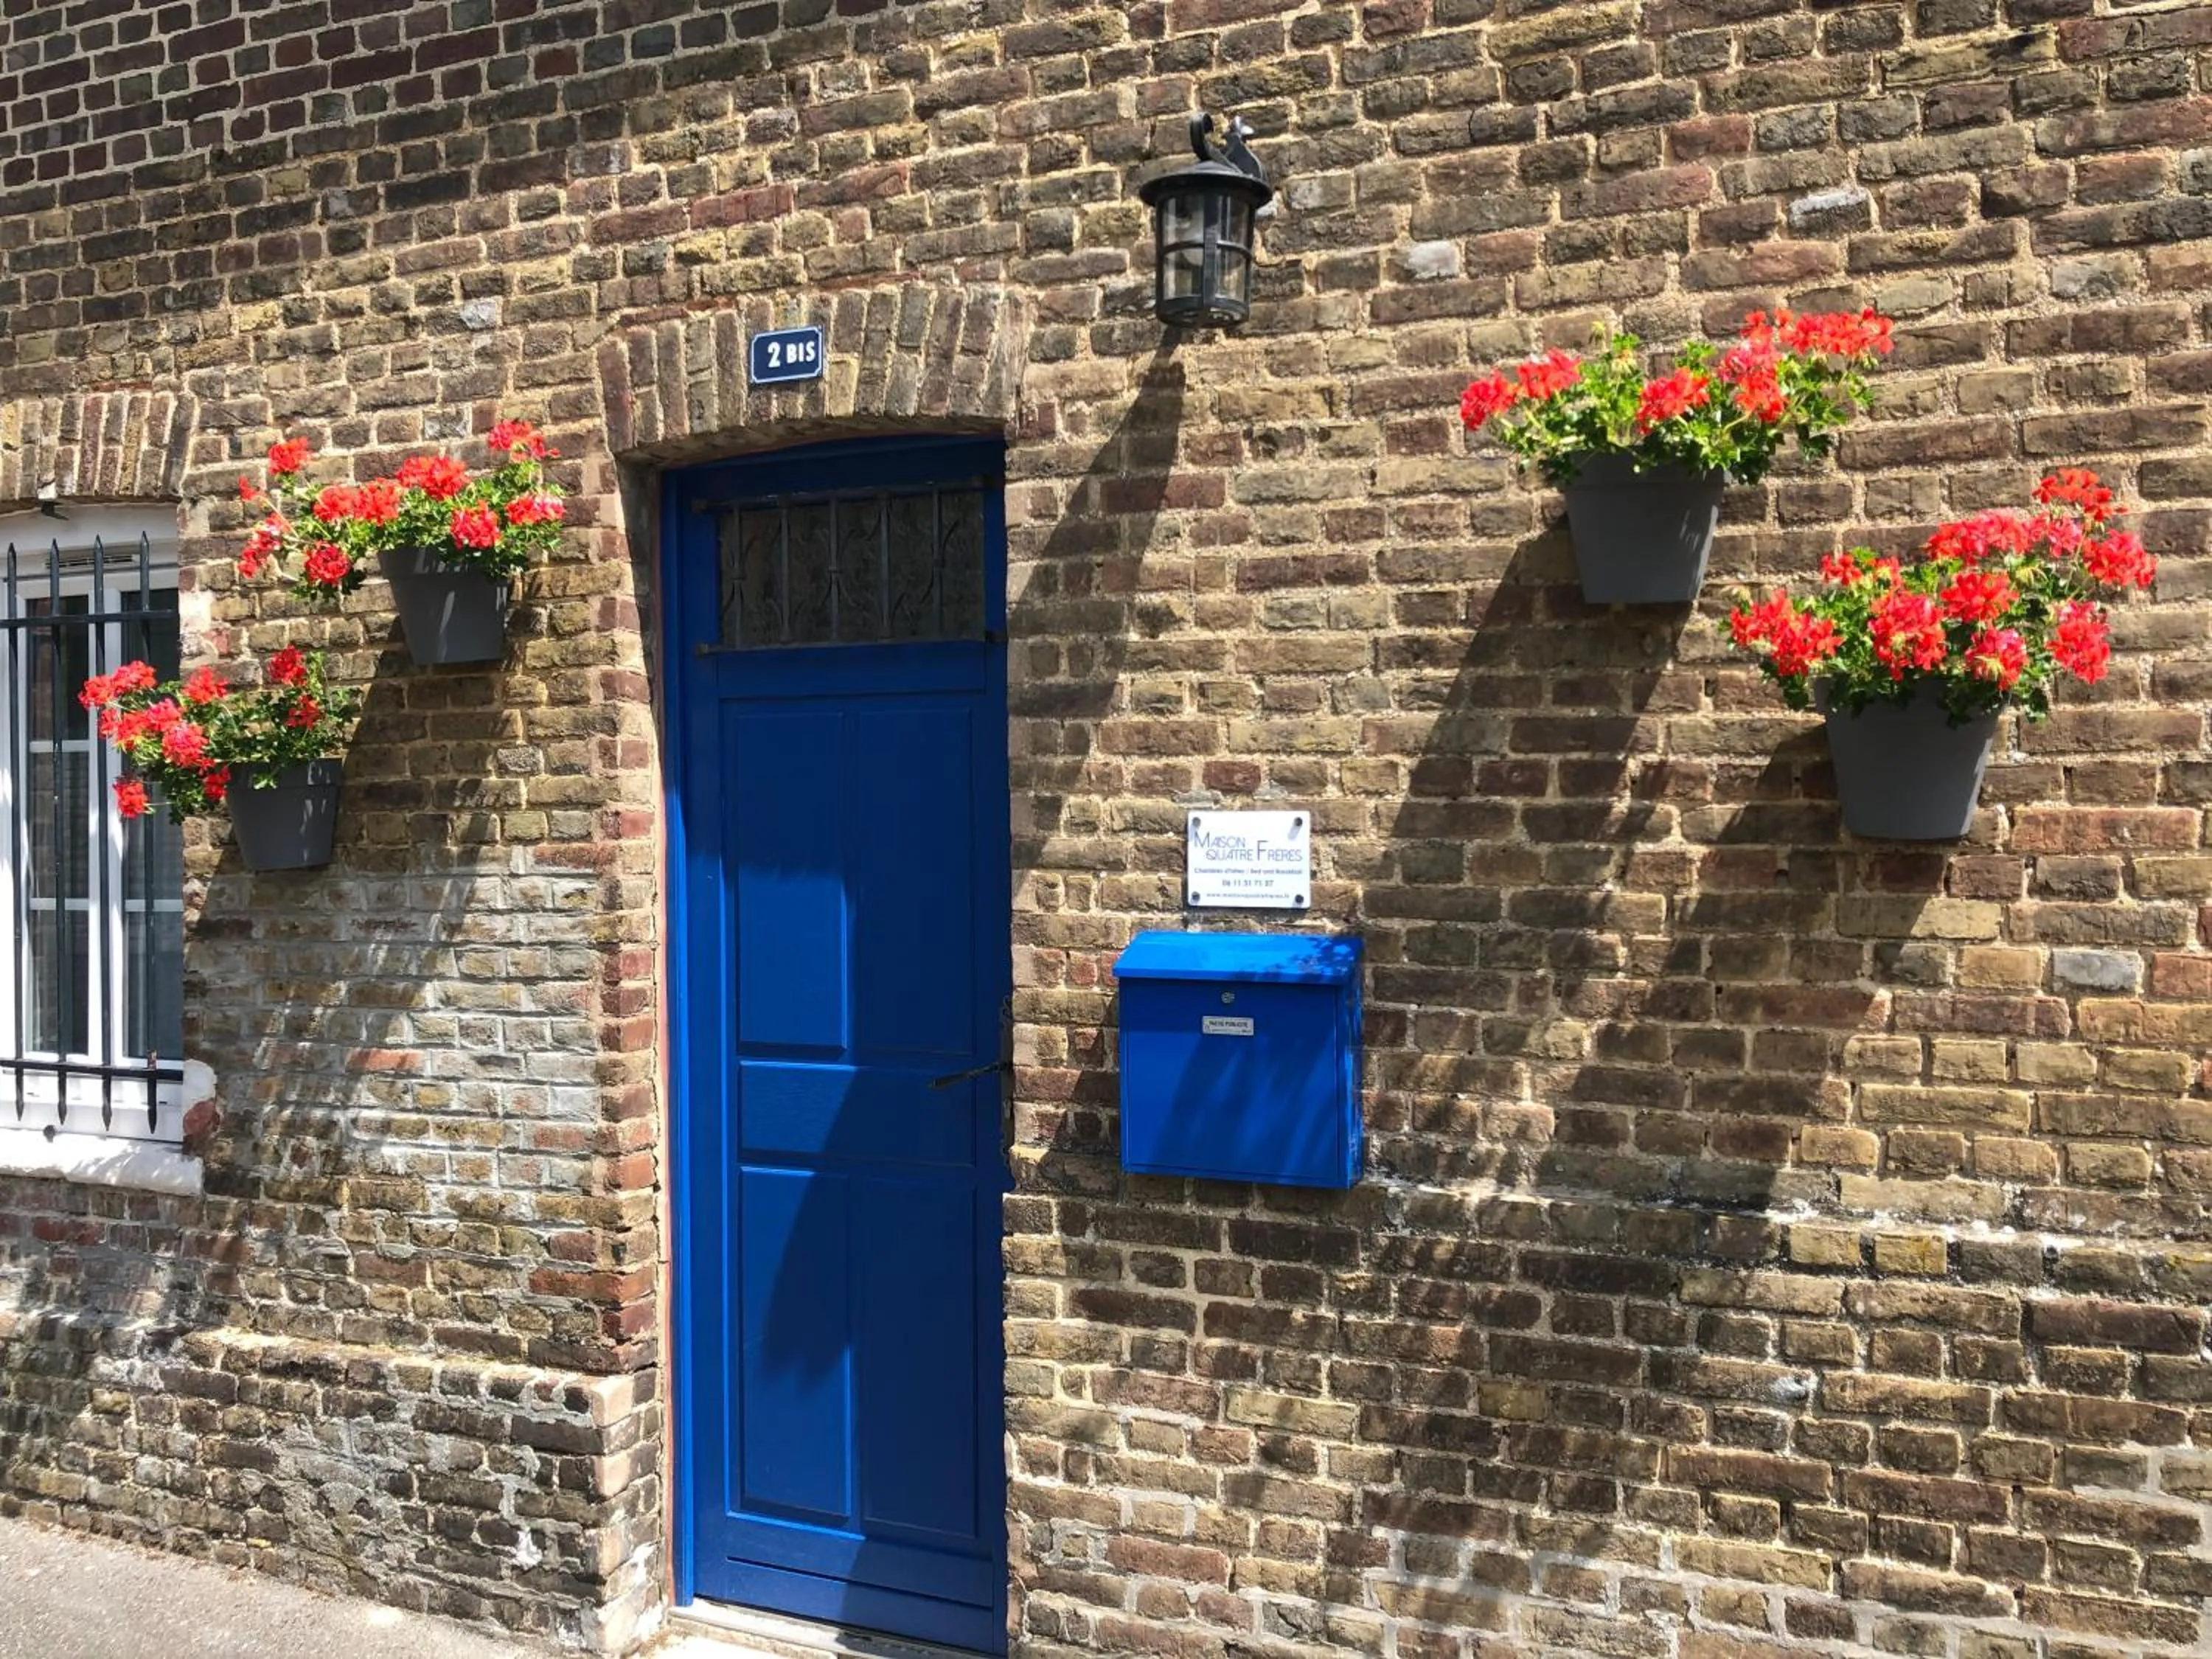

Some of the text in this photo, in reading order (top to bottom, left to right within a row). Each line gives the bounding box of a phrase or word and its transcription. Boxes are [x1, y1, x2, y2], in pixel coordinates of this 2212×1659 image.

[768, 341, 816, 368] 2 BIS
[1194, 831, 1246, 849] MAISON
[1205, 849, 1254, 861] QUATRE
